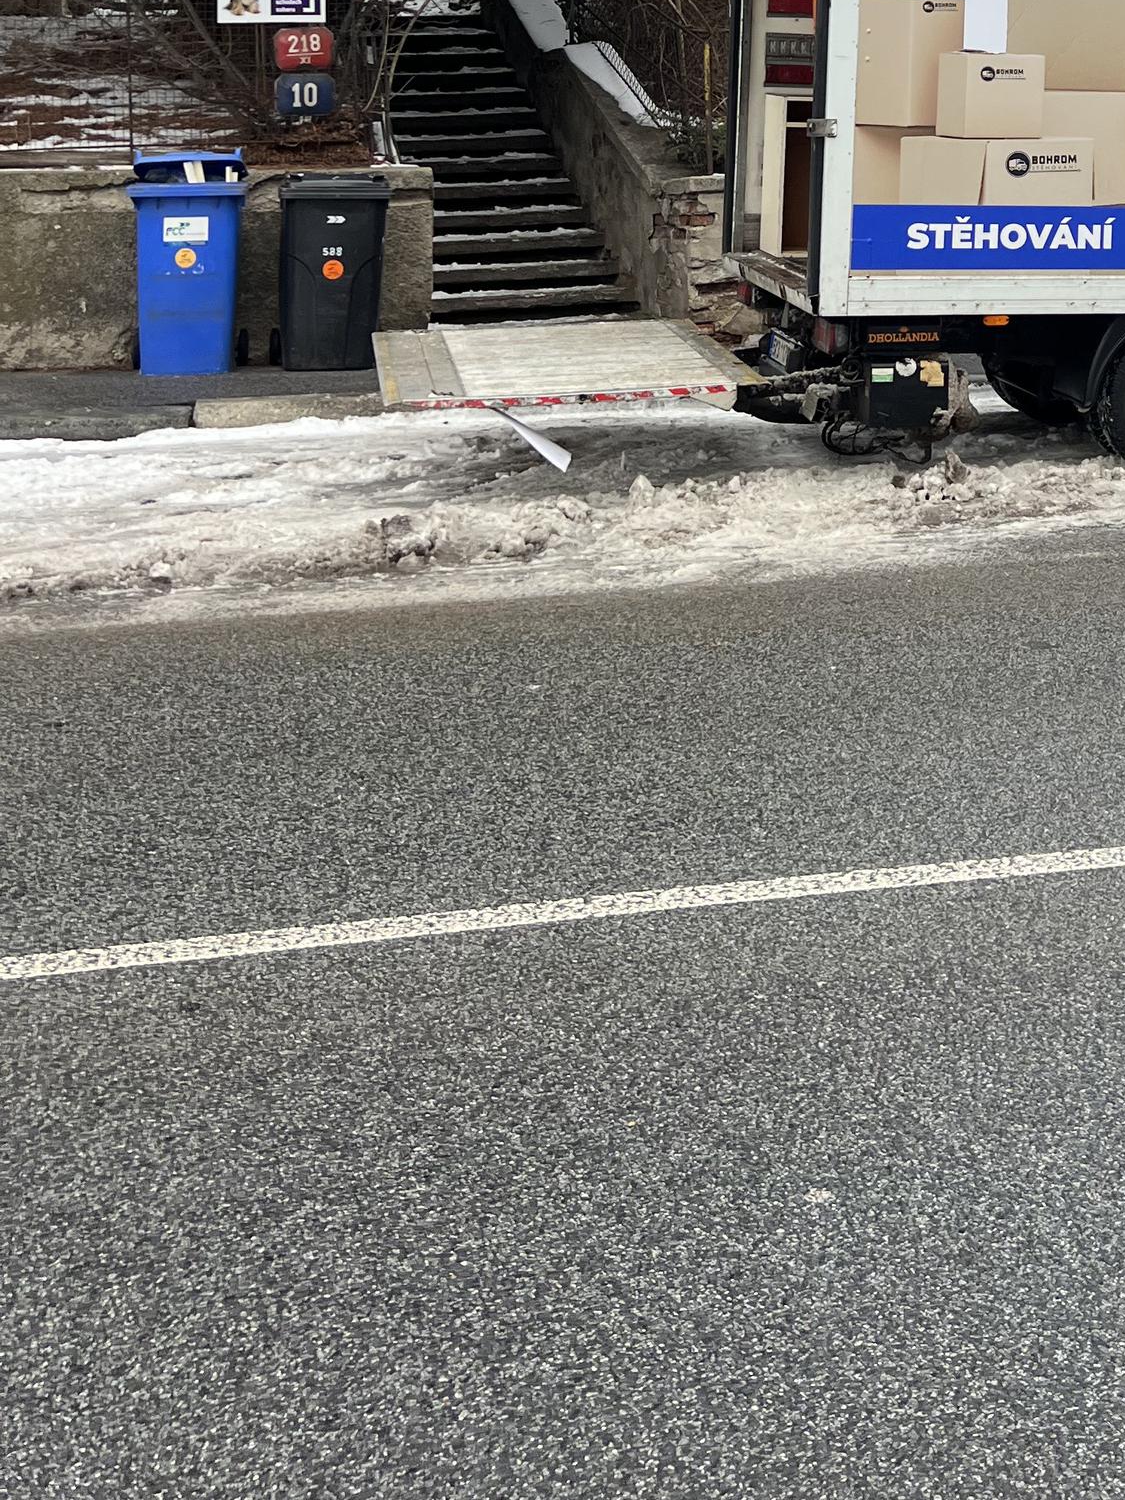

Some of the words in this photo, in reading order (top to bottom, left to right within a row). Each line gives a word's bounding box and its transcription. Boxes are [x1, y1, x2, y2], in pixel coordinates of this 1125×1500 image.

[287, 33, 321, 53] 218
[291, 82, 318, 108] 10
[1031, 155, 1077, 164] BOHROM
[907, 216, 1115, 250] STĚHOVÁNÍ
[868, 332, 940, 344] DHOLLANDIA
